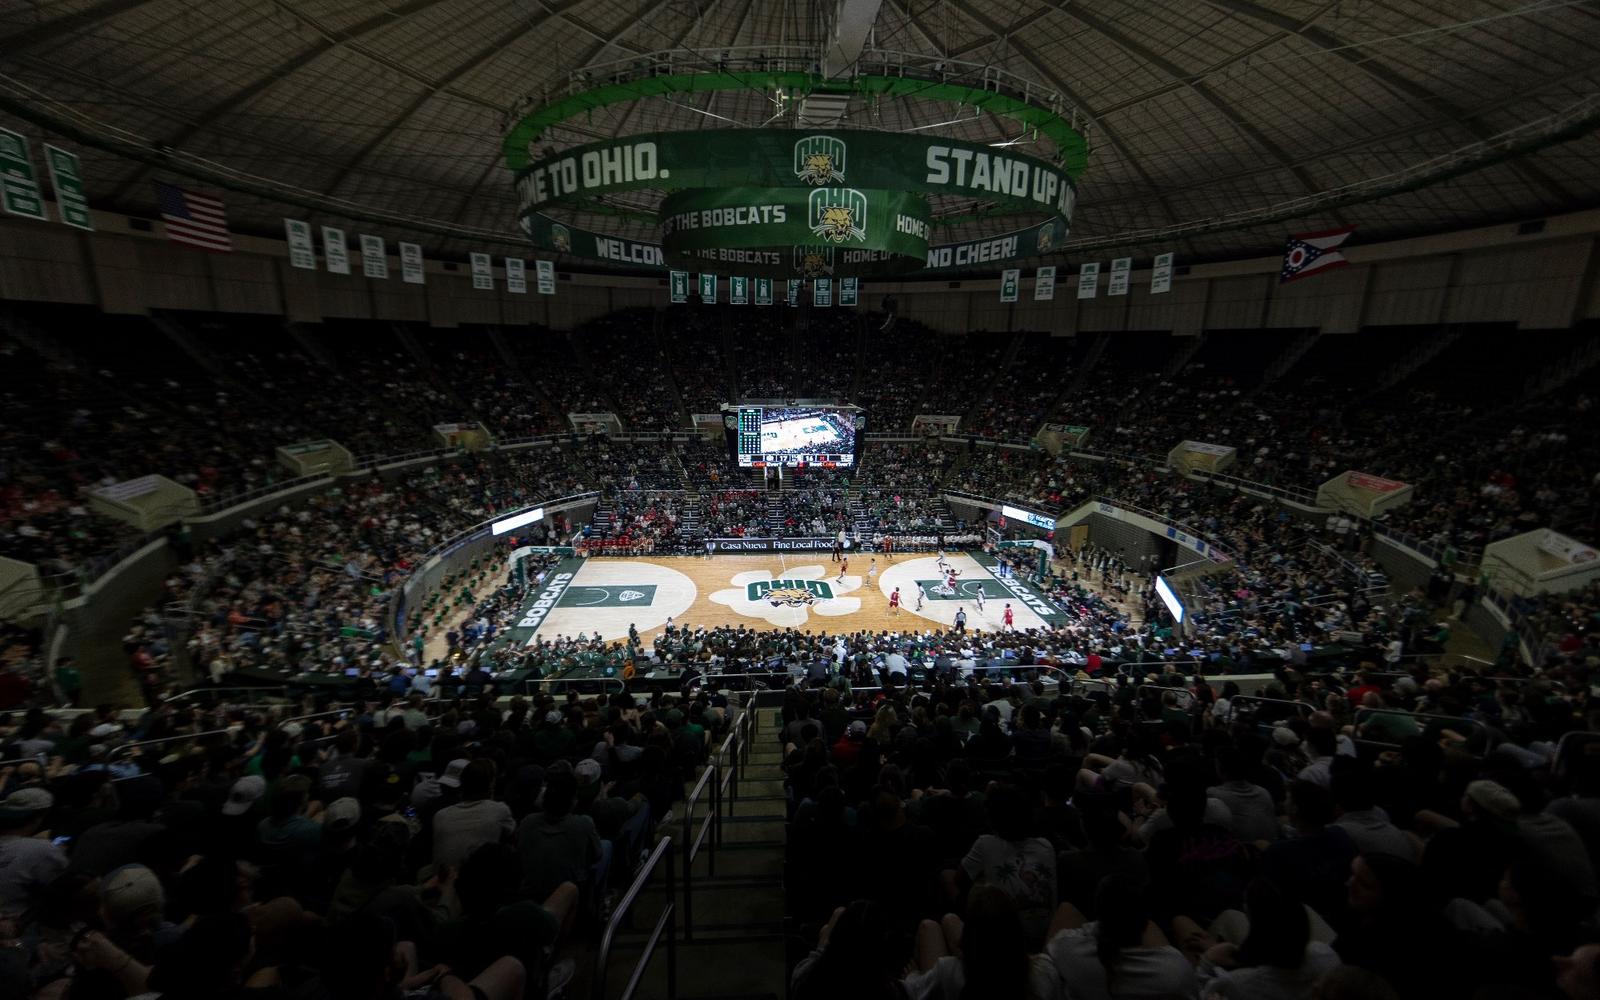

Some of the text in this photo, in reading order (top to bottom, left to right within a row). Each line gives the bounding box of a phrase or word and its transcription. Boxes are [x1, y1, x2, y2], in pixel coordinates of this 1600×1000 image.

[547, 157, 578, 197] TO
[581, 141, 670, 188] OHIO.
[926, 145, 1030, 198] STAND
[1032, 166, 1058, 205] UP
[674, 211, 699, 231] THE
[701, 204, 786, 229] BOBCATS
[896, 214, 925, 239] HOME
[719, 248, 781, 265] BOBCATS
[843, 250, 878, 263] HOME
[924, 236, 1018, 268] ND CHEER!
[720, 541, 767, 550] Casa Nueva
[773, 541, 791, 549] Fine
[791, 540, 813, 549] Local
[517, 572, 573, 627] BOBCATS
[747, 579, 834, 601] OHIO
[986, 565, 1055, 616] BBCATS
